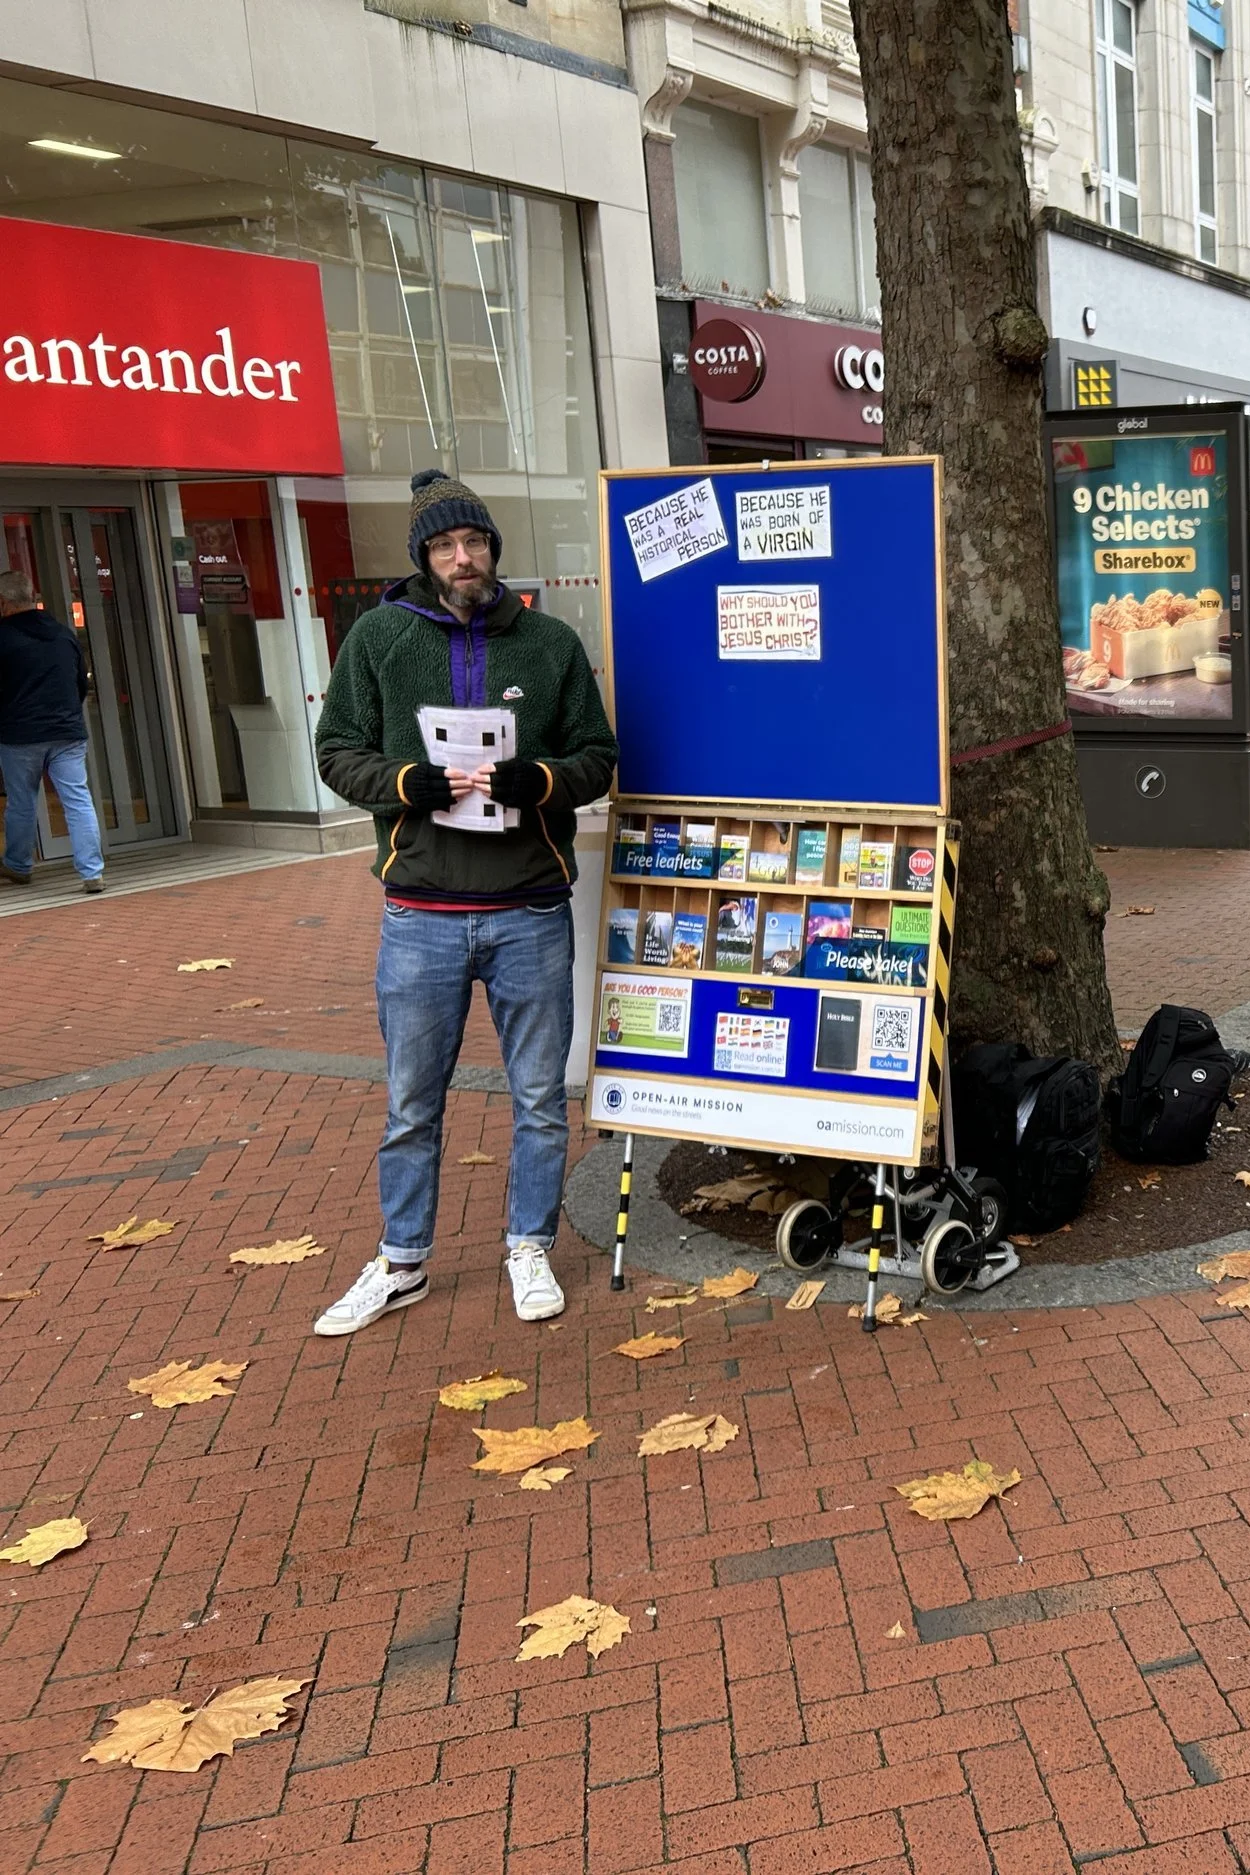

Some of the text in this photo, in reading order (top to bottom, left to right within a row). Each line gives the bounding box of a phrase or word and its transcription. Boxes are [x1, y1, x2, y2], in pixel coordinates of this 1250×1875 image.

[3, 327, 301, 402] antander
[694, 345, 749, 365] COSTA
[708, 366, 738, 375] COFFEE
[835, 345, 884, 393] CO
[862, 405, 883, 425] CO
[1117, 418, 1148, 433] global
[740, 490, 827, 514] BECAUSE HE
[1072, 482, 1209, 513] 9 Chicken
[628, 486, 709, 535] BECAUSE HE
[740, 510, 824, 530] WAS BORN OF
[632, 507, 704, 548] WAS A REAL
[638, 529, 696, 563] HISTORICAL
[677, 528, 726, 561] PERSON
[743, 527, 814, 554] A VIRGIN
[720, 592, 818, 611] WHY SHOULD YOU
[1200, 600, 1219, 608] NEW
[720, 611, 805, 630] BOTHER WITH
[720, 630, 762, 649] JESUS
[626, 851, 703, 871] Free leaflets
[911, 857, 932, 868] STOP
[901, 911, 928, 922] ULTIMATE
[895, 922, 929, 933] QUESTIONS
[644, 948, 667, 956] Worth
[826, 951, 872, 970] Please
[605, 982, 688, 997] ARE YOU A GOOD PERSON?
[734, 1051, 784, 1065] Read online!
[876, 1060, 903, 1069] SCAN ME
[631, 1104, 647, 1113] Good
[632, 1091, 743, 1112] OPEN-AIR MISSION
[816, 1119, 904, 1139] oamission.com
